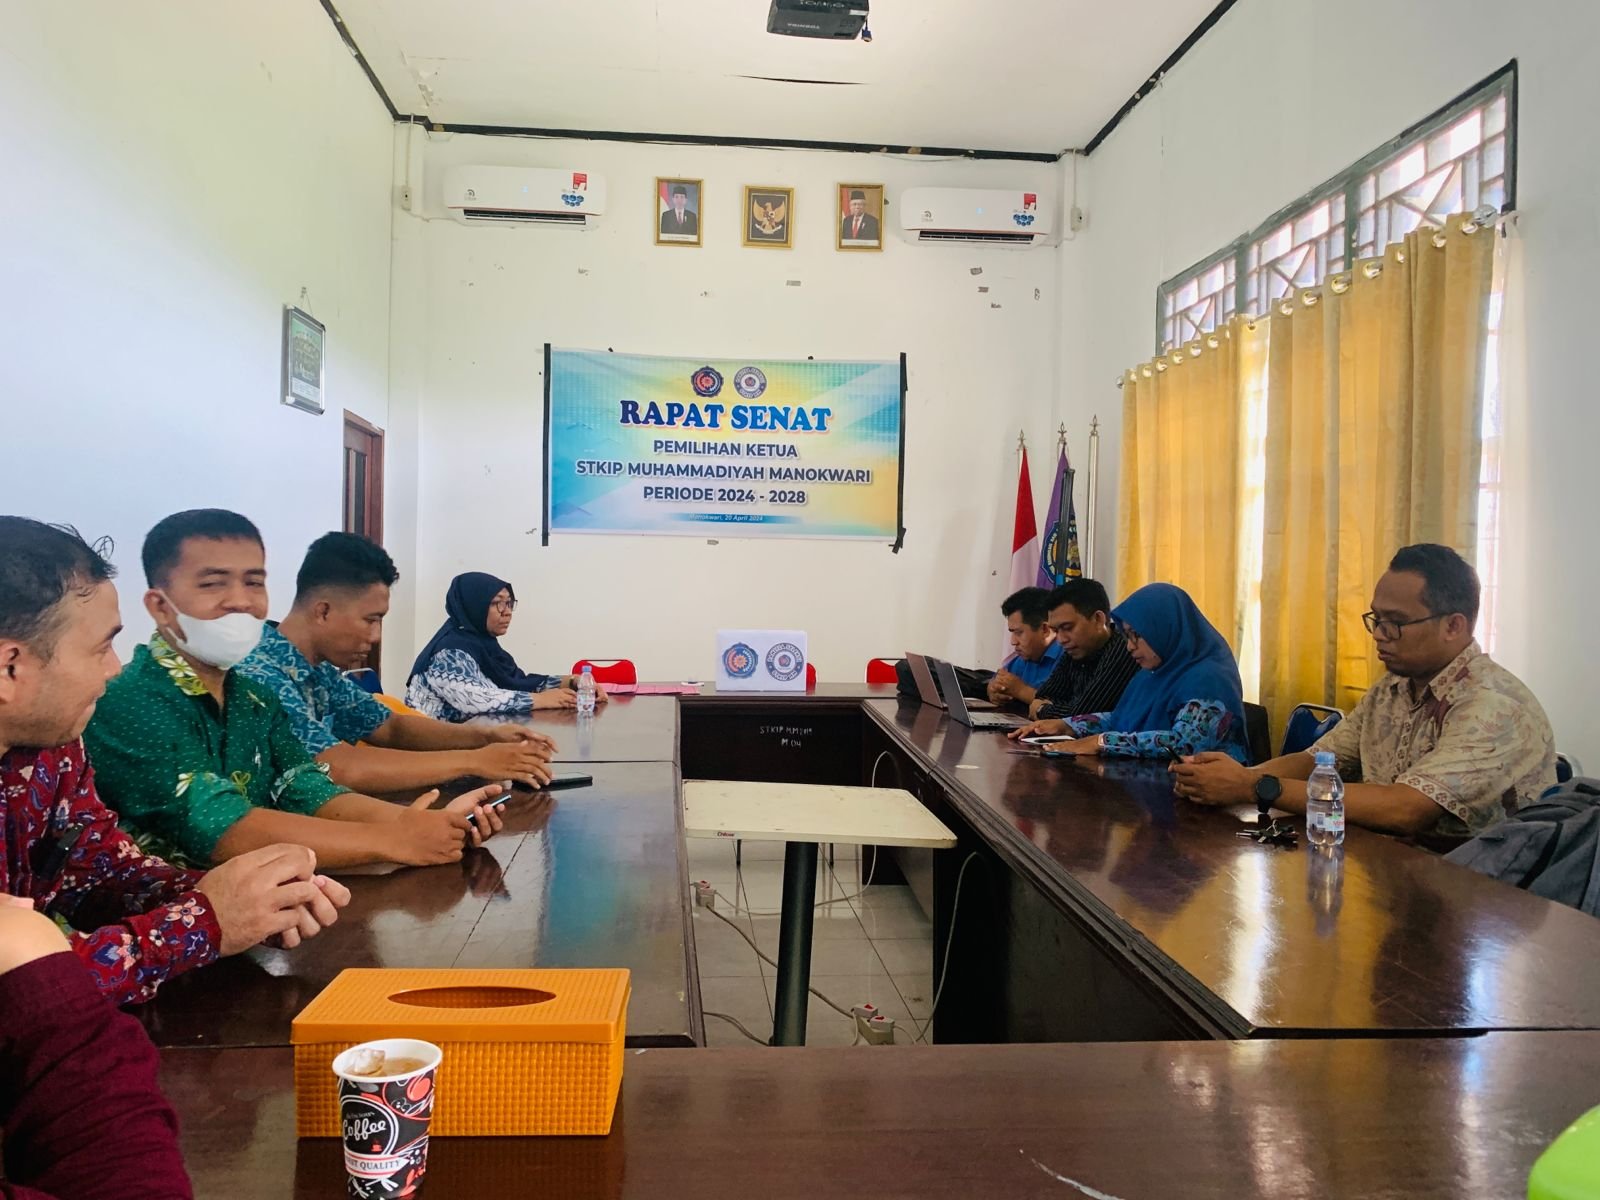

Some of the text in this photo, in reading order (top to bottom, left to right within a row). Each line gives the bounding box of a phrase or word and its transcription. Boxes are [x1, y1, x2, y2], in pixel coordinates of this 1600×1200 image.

[619, 400, 831, 431] RAPAT SENAT
[653, 440, 798, 457] PEMILIHAN KETUA
[576, 461, 870, 482] STKIP MUHAMMADIYAH MANOKWARI
[643, 486, 713, 501] PERIODE
[717, 489, 755, 502] 2024
[769, 490, 805, 503] 2028
[733, 514, 748, 522] April
[342, 1118, 387, 1141] Coffee
[360, 1160, 400, 1170] QUALITY
